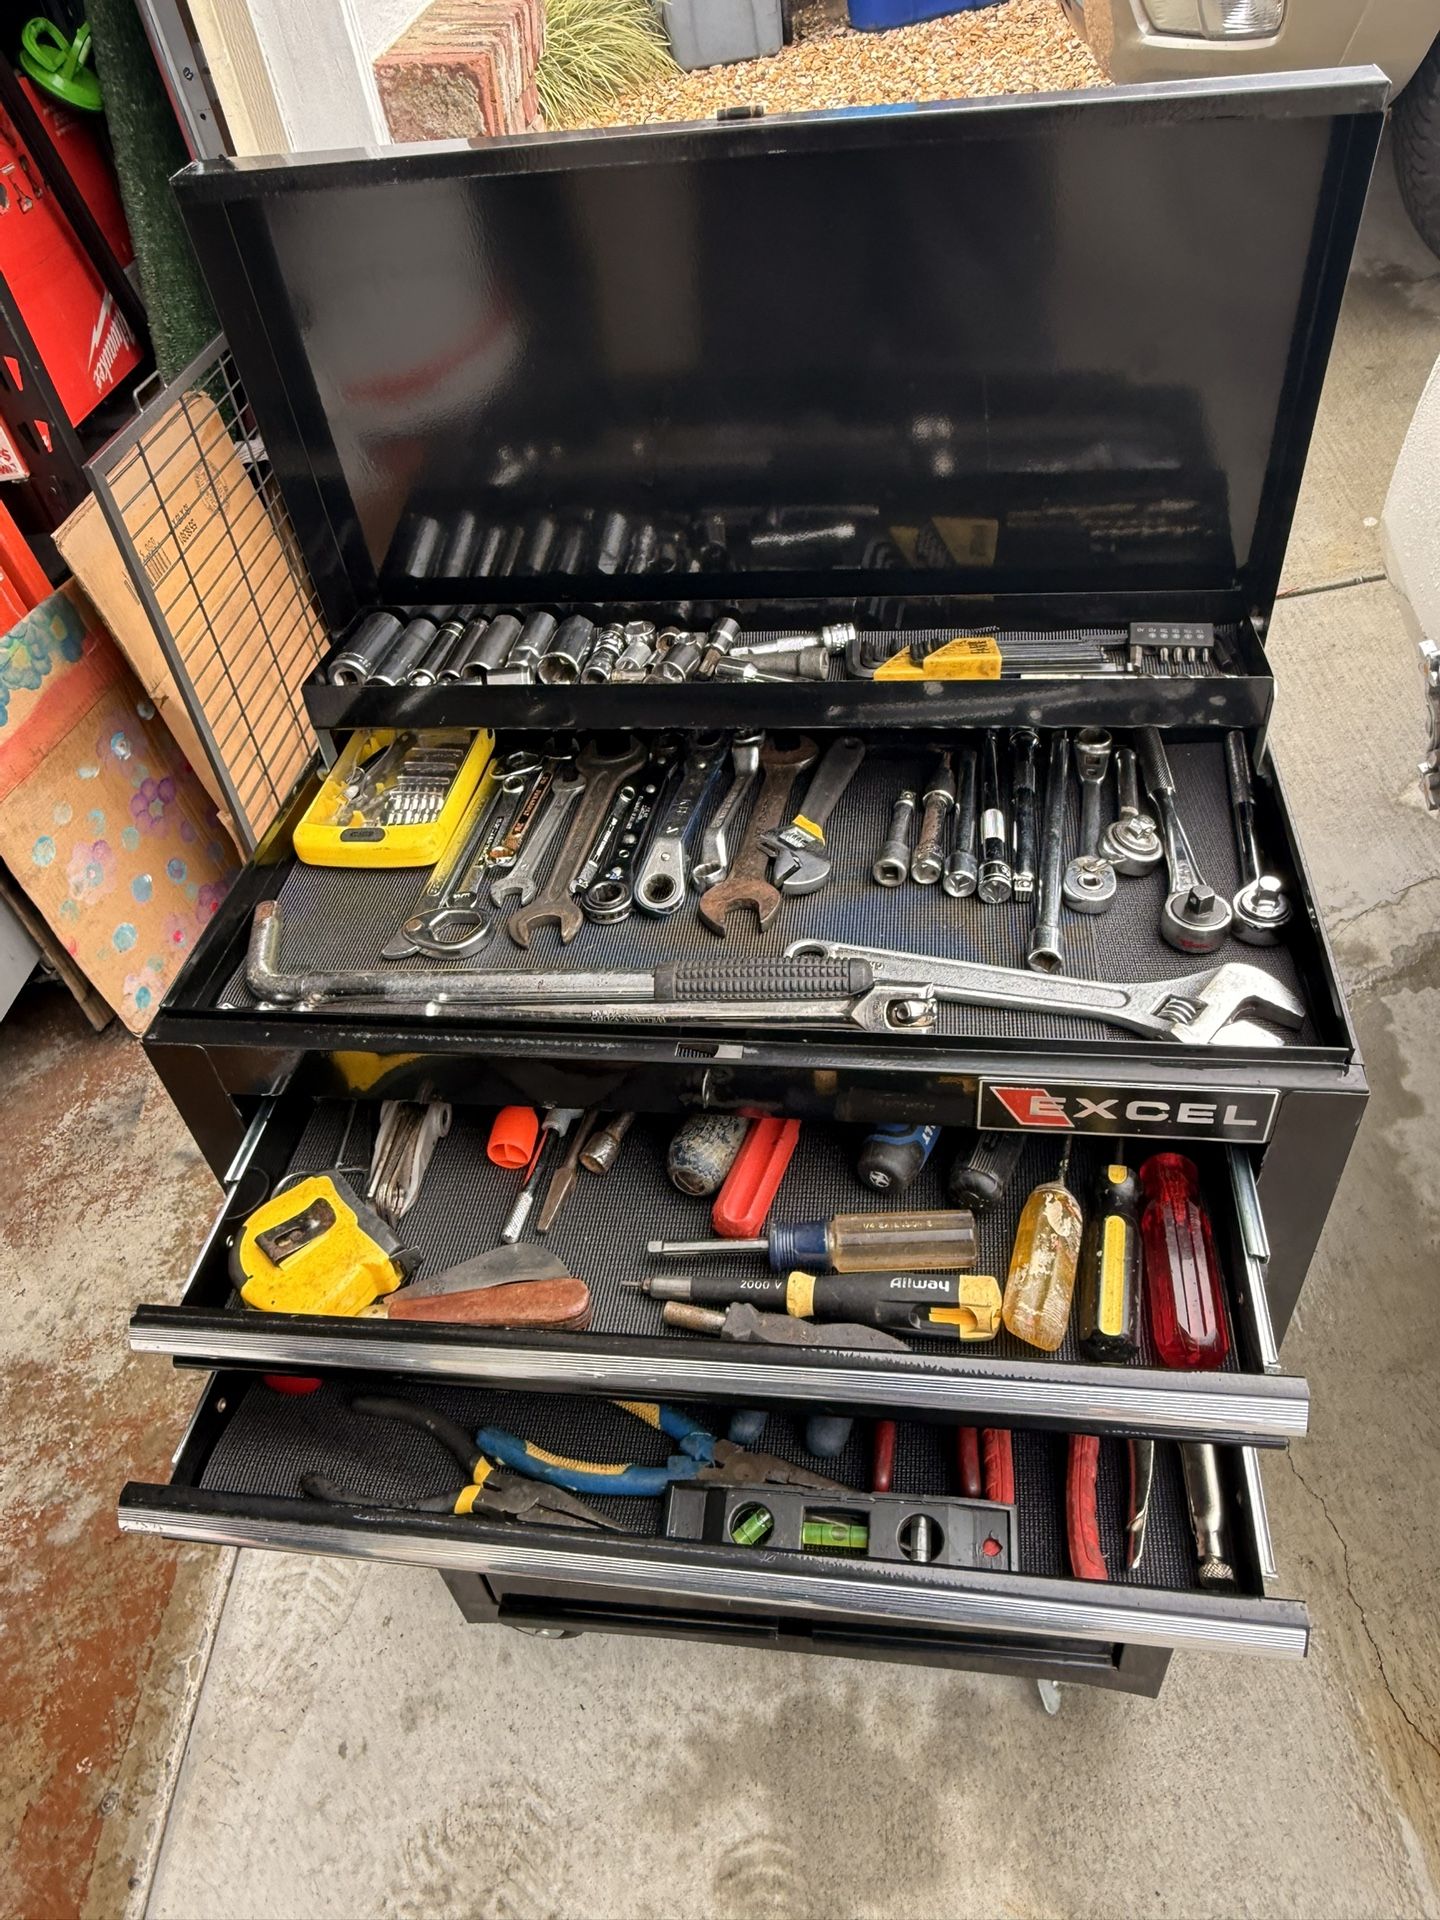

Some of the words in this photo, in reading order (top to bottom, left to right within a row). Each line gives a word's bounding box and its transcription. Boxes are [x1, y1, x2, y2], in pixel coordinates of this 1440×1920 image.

[1029, 1096, 1257, 1126] EXCEL
[740, 1280, 769, 1289] 2000
[775, 1280, 782, 1289] V
[890, 1277, 950, 1292] Allway
